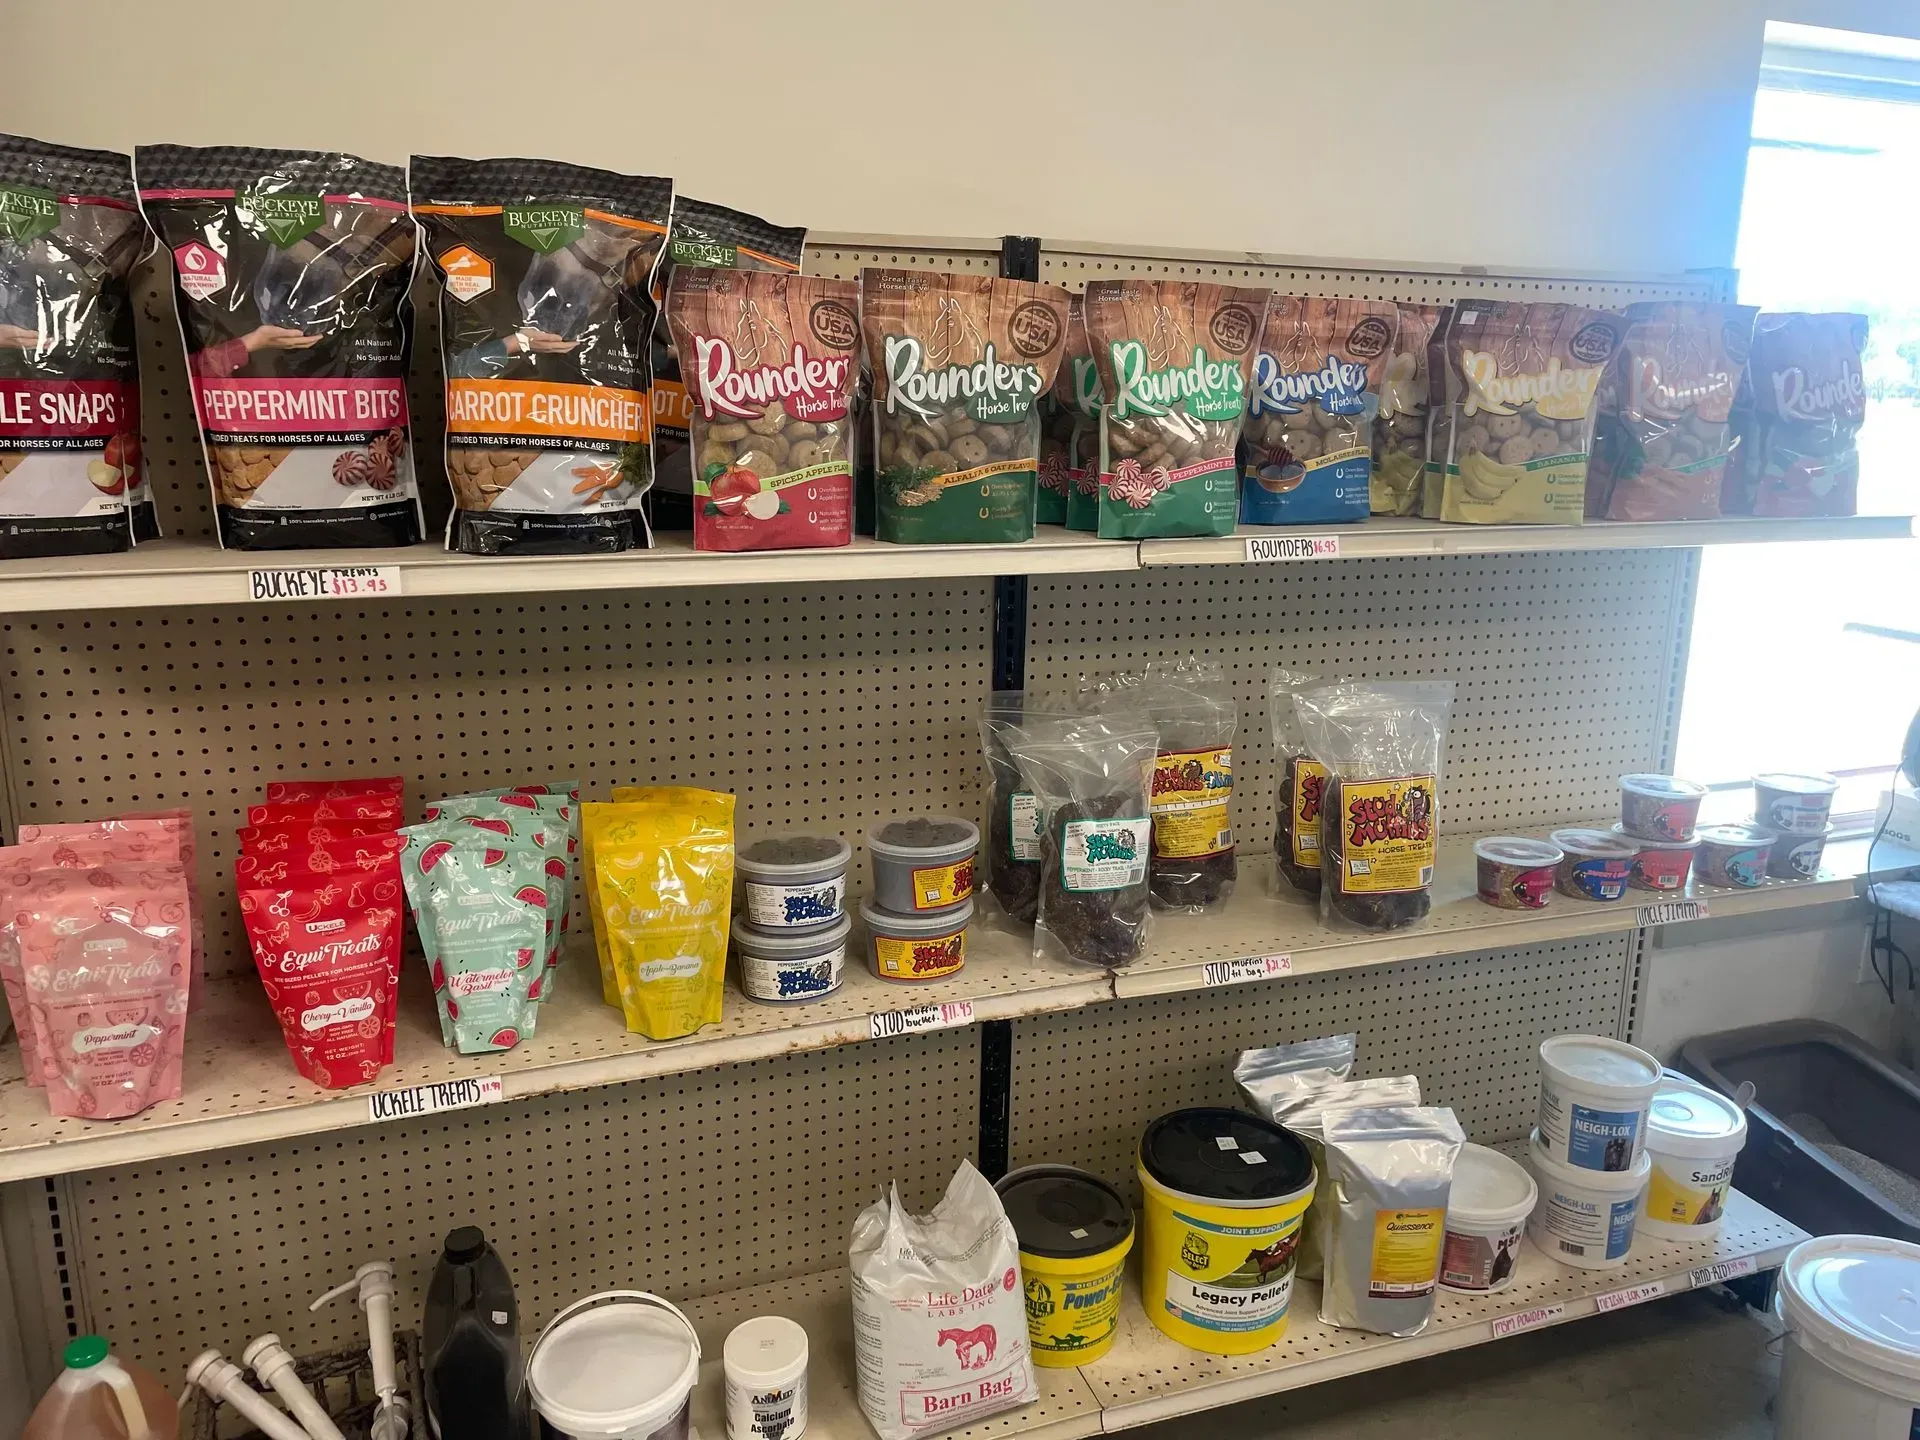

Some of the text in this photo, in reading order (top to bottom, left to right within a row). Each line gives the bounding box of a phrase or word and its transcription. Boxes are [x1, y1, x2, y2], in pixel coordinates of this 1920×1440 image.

[0, 191, 55, 216] CKEYE
[241, 196, 321, 217] BUCKEYE
[508, 210, 580, 228] BUCKEYE
[674, 243, 733, 262] BUCKEYE
[815, 315, 855, 338] USA
[1015, 316, 1050, 346] USA
[1215, 320, 1247, 344] USA
[355, 339, 392, 347] All Natural
[1351, 333, 1381, 350] USA
[356, 354, 388, 363] No Sugar
[617, 363, 635, 374] Sugar
[885, 336, 1043, 415] Rounders
[1113, 342, 1244, 416] Rounders
[1462, 349, 1603, 417] Rounder
[1772, 360, 1861, 424] Rounde
[39, 391, 115, 425] SNAPS
[203, 388, 400, 421] PEPPERMINT BITS
[449, 391, 525, 422] CARROT
[532, 393, 643, 433] CRUNCHER
[796, 395, 828, 418] Horse
[977, 397, 1010, 419] Horse
[1196, 396, 1222, 418] Horse
[12, 438, 104, 449] HORSES OF ALL AGES
[230, 433, 366, 443] TREATS FOR HORSES OF ALL AGES
[479, 437, 509, 445] TREATS
[529, 438, 562, 447] HORSES
[563, 439, 573, 447] OF
[591, 441, 610, 450] AGES
[770, 473, 804, 488] SPICED
[805, 466, 833, 478] APPLE
[990, 464, 1006, 473] OAT
[1172, 461, 1224, 480] PEPPERMINT
[1251, 538, 1314, 560] ROUNDERS
[252, 570, 329, 599] BUCKEYE
[332, 579, 388, 595] $13.95
[1378, 841, 1433, 854] HORSE TREATS
[308, 920, 346, 933] UCKELE
[1636, 905, 1663, 928] UNCLE
[285, 975, 302, 983] SIZED
[303, 971, 329, 981] PELLETS
[344, 963, 368, 972] HORSES
[1231, 958, 1263, 968] muffins
[450, 969, 516, 989] Watermelon
[1205, 961, 1231, 986] STUD
[461, 981, 493, 996] Basil
[904, 1005, 939, 1017] muffin
[873, 1011, 904, 1037] STUD
[84, 1029, 137, 1046] Peppermint
[371, 1087, 425, 1119] UCKELE
[426, 1079, 480, 1109] TREATS
[1574, 1119, 1631, 1137] NEIGH-LOX
[1554, 1191, 1597, 1214] NEIGH-LOX
[1221, 1222, 1286, 1236] JOINT SUPPORT
[1386, 1221, 1435, 1232] Quiessence
[1182, 1247, 1209, 1266] SELECT
[927, 1291, 959, 1308] Life
[962, 1282, 994, 1303] Data
[1192, 1280, 1290, 1308] Legacy Pellets
[927, 1307, 965, 1319] LABS
[1195, 1303, 1224, 1315] Advanced
[1495, 1316, 1516, 1337] MSM
[1516, 1309, 1548, 1328] POWDER
[923, 1375, 1013, 1413] Barn Bag
[750, 1416, 795, 1434] Ascorbate
[754, 1407, 792, 1423] Calcium
